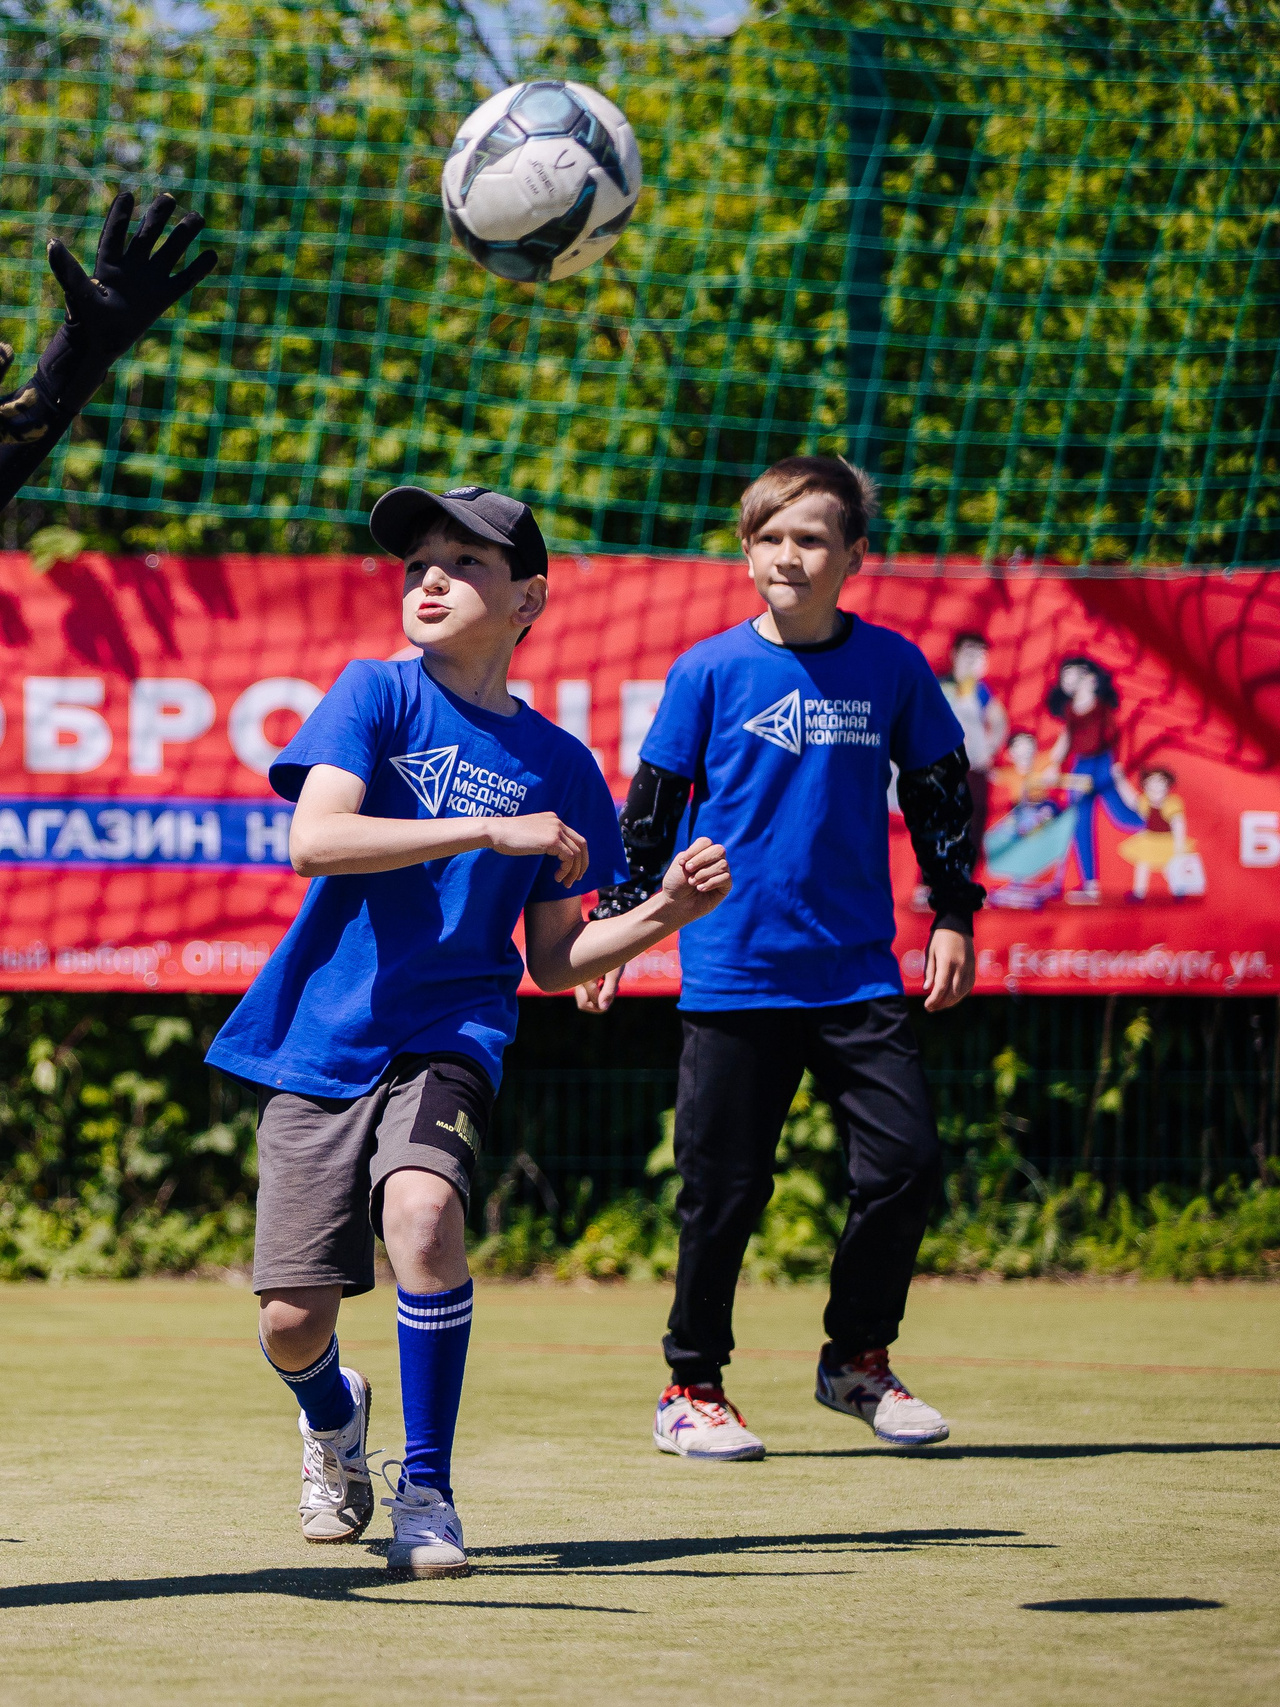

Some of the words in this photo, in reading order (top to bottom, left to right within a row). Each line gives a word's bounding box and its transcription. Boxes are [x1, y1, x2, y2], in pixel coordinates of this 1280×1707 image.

[804, 699, 871, 716] РУССКАЯ
[805, 714, 867, 730] МЕДНАЯ
[805, 729, 881, 747] КОМПАНИЯ
[457, 760, 528, 801] РУССКАЯ
[452, 776, 520, 816] МЕДНАЯ
[436, 1120, 455, 1132] MAD
